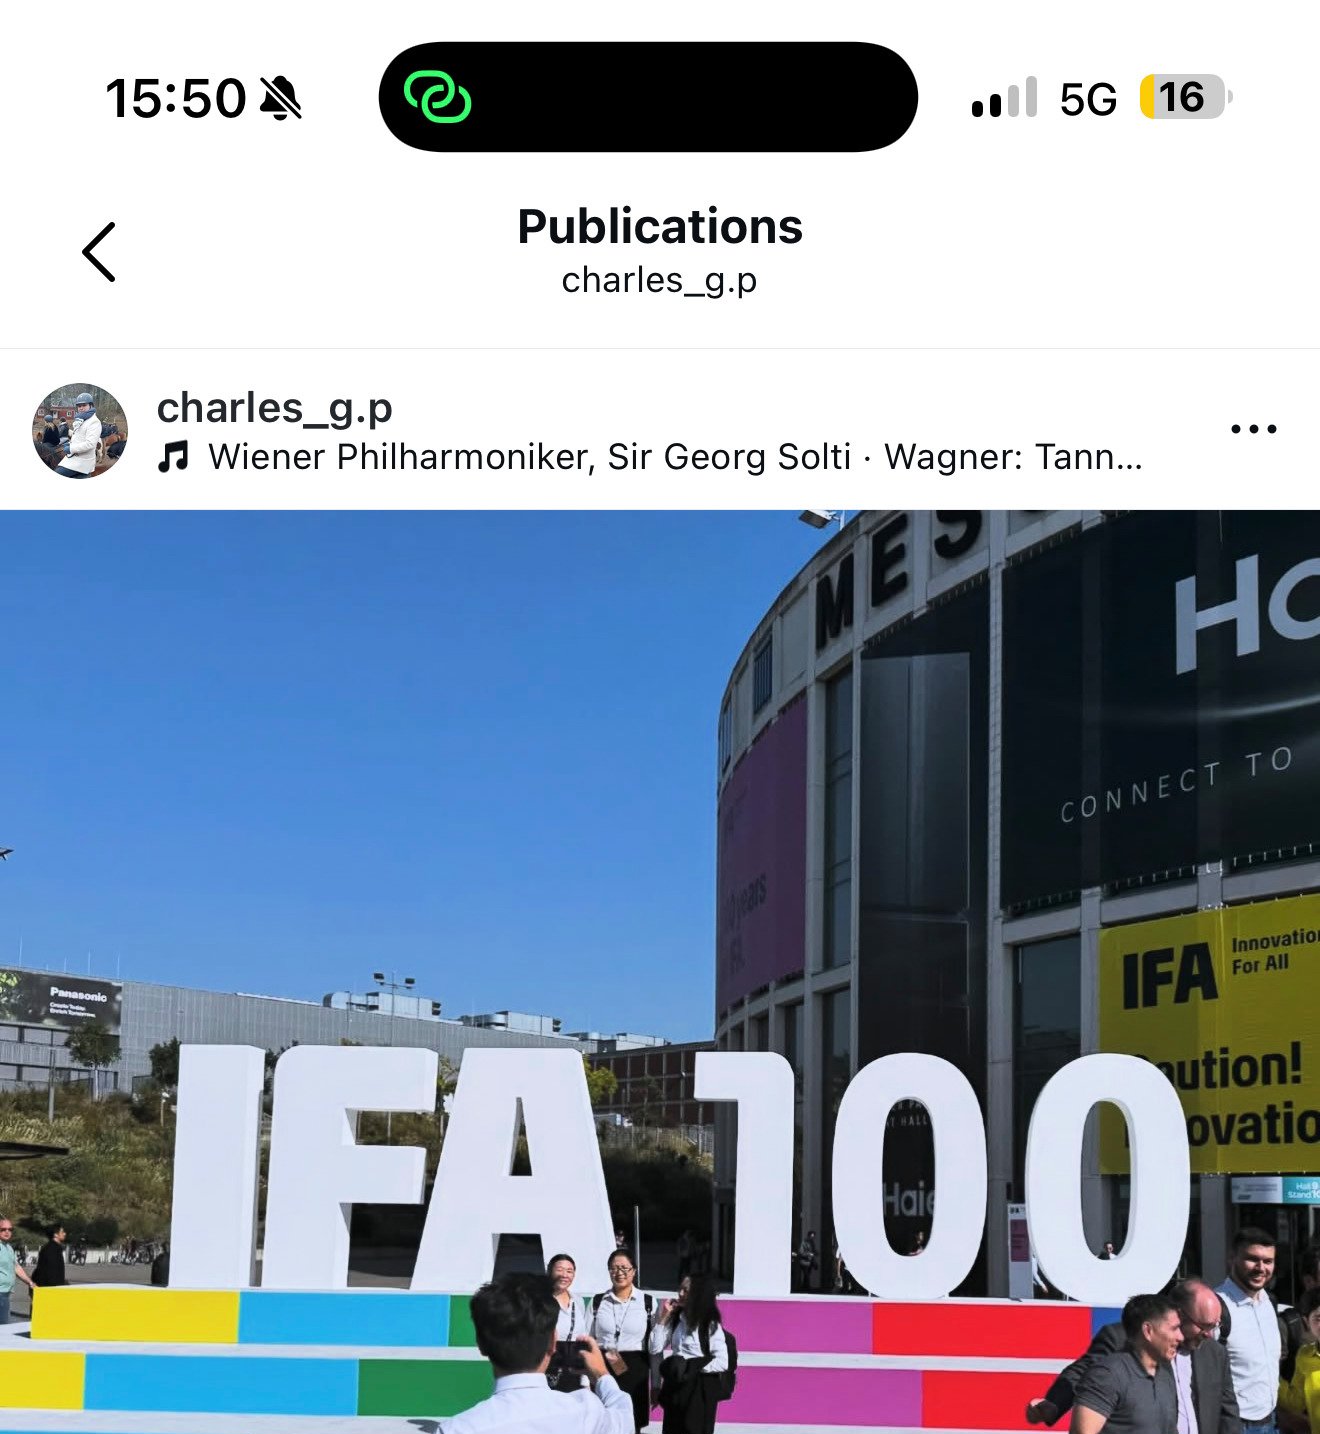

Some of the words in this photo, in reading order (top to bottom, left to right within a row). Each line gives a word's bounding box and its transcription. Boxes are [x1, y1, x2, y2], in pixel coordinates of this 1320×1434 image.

[816, 510, 983, 651] MES
[1061, 762, 1220, 822] CONNECT
[1245, 747, 1291, 776] TO
[50, 987, 107, 1002] Panasonic
[1123, 942, 1219, 1010] IFA
[1232, 959, 1260, 975] For
[1265, 953, 1288, 971] All
[1134, 1041, 1301, 1090] aution!
[169, 1044, 615, 1289] IFA
[695, 1052, 1190, 1303] 100
